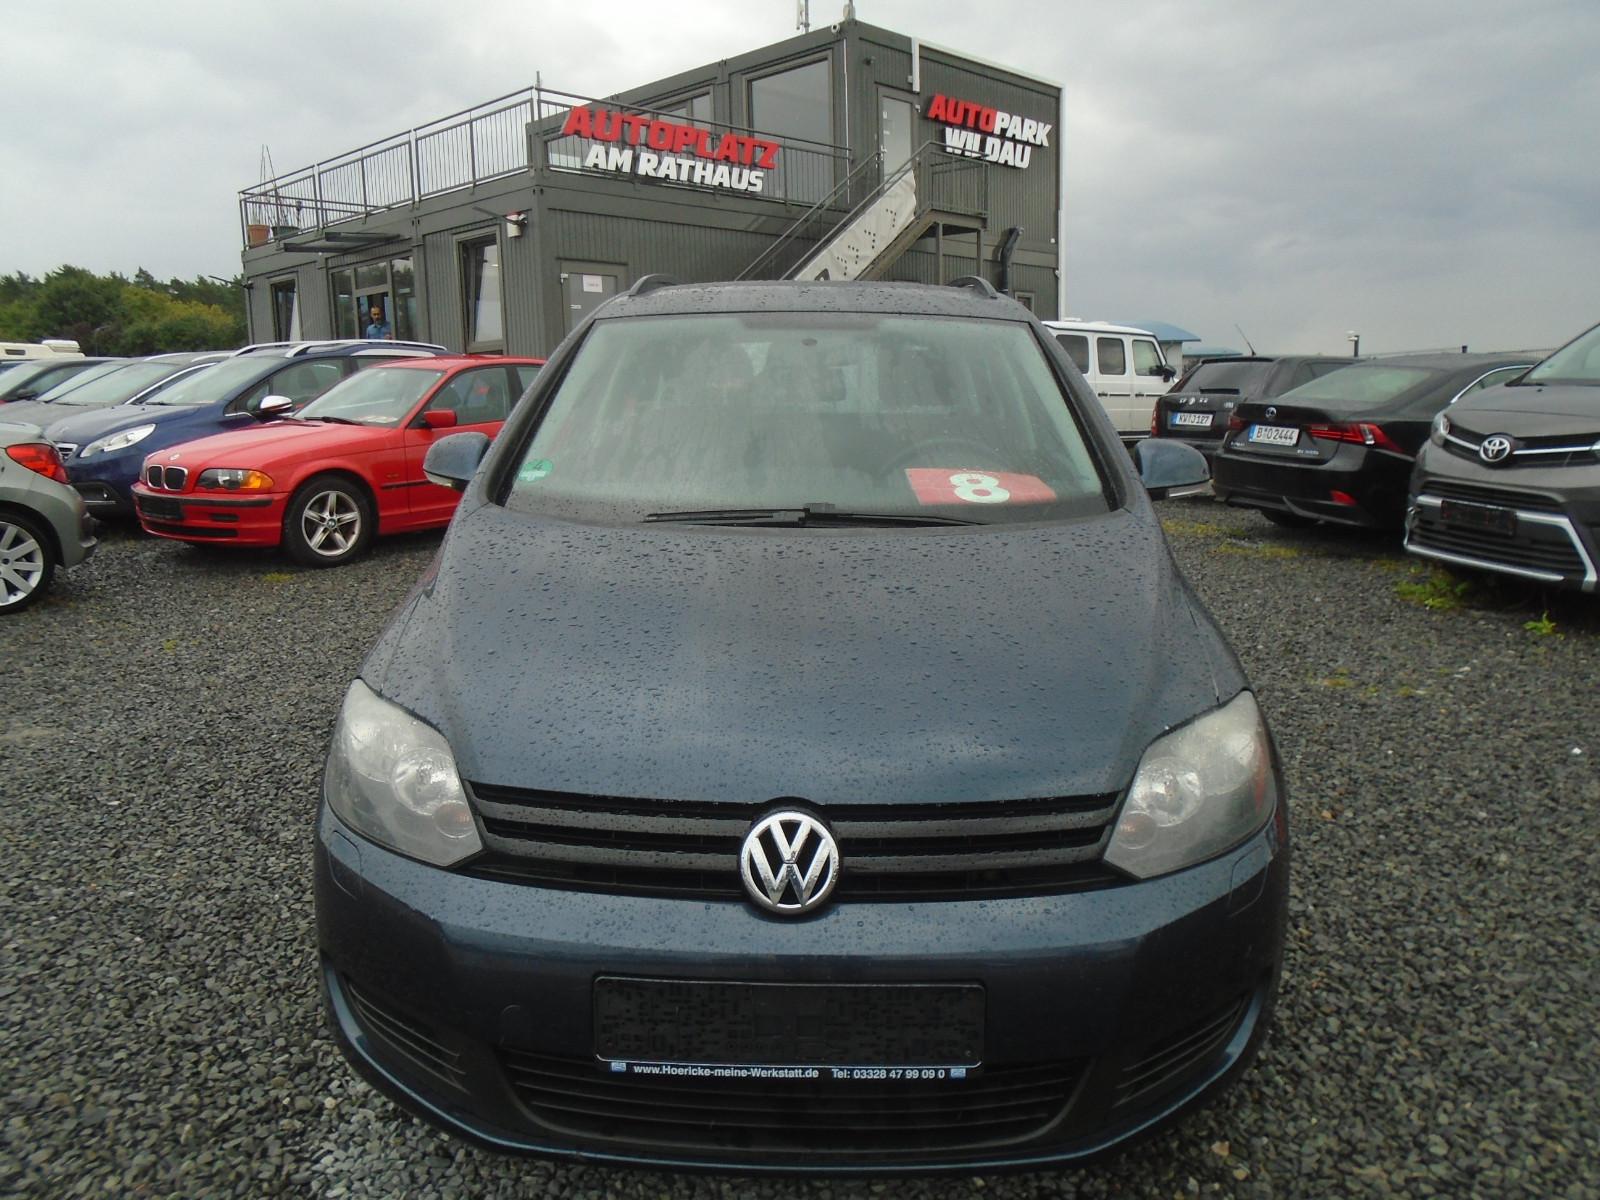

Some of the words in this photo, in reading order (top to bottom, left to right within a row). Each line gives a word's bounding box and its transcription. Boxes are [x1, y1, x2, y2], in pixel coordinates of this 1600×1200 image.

[561, 106, 780, 169] AUTOPLATZ
[928, 94, 1052, 147] AUTOPARK
[584, 144, 633, 173] AM
[638, 152, 765, 192] RATHAUS
[945, 127, 1031, 169] WILDAU
[949, 473, 1010, 504] 8
[634, 1064, 819, 1079] www.Hoericke-meine-Werkstatt.de
[832, 1068, 851, 1079] Tel:
[853, 1068, 886, 1080] 03328
[889, 1069, 901, 1080] 47
[905, 1069, 919, 1080] 99
[922, 1069, 935, 1080] 09
[938, 1069, 945, 1079] 0
